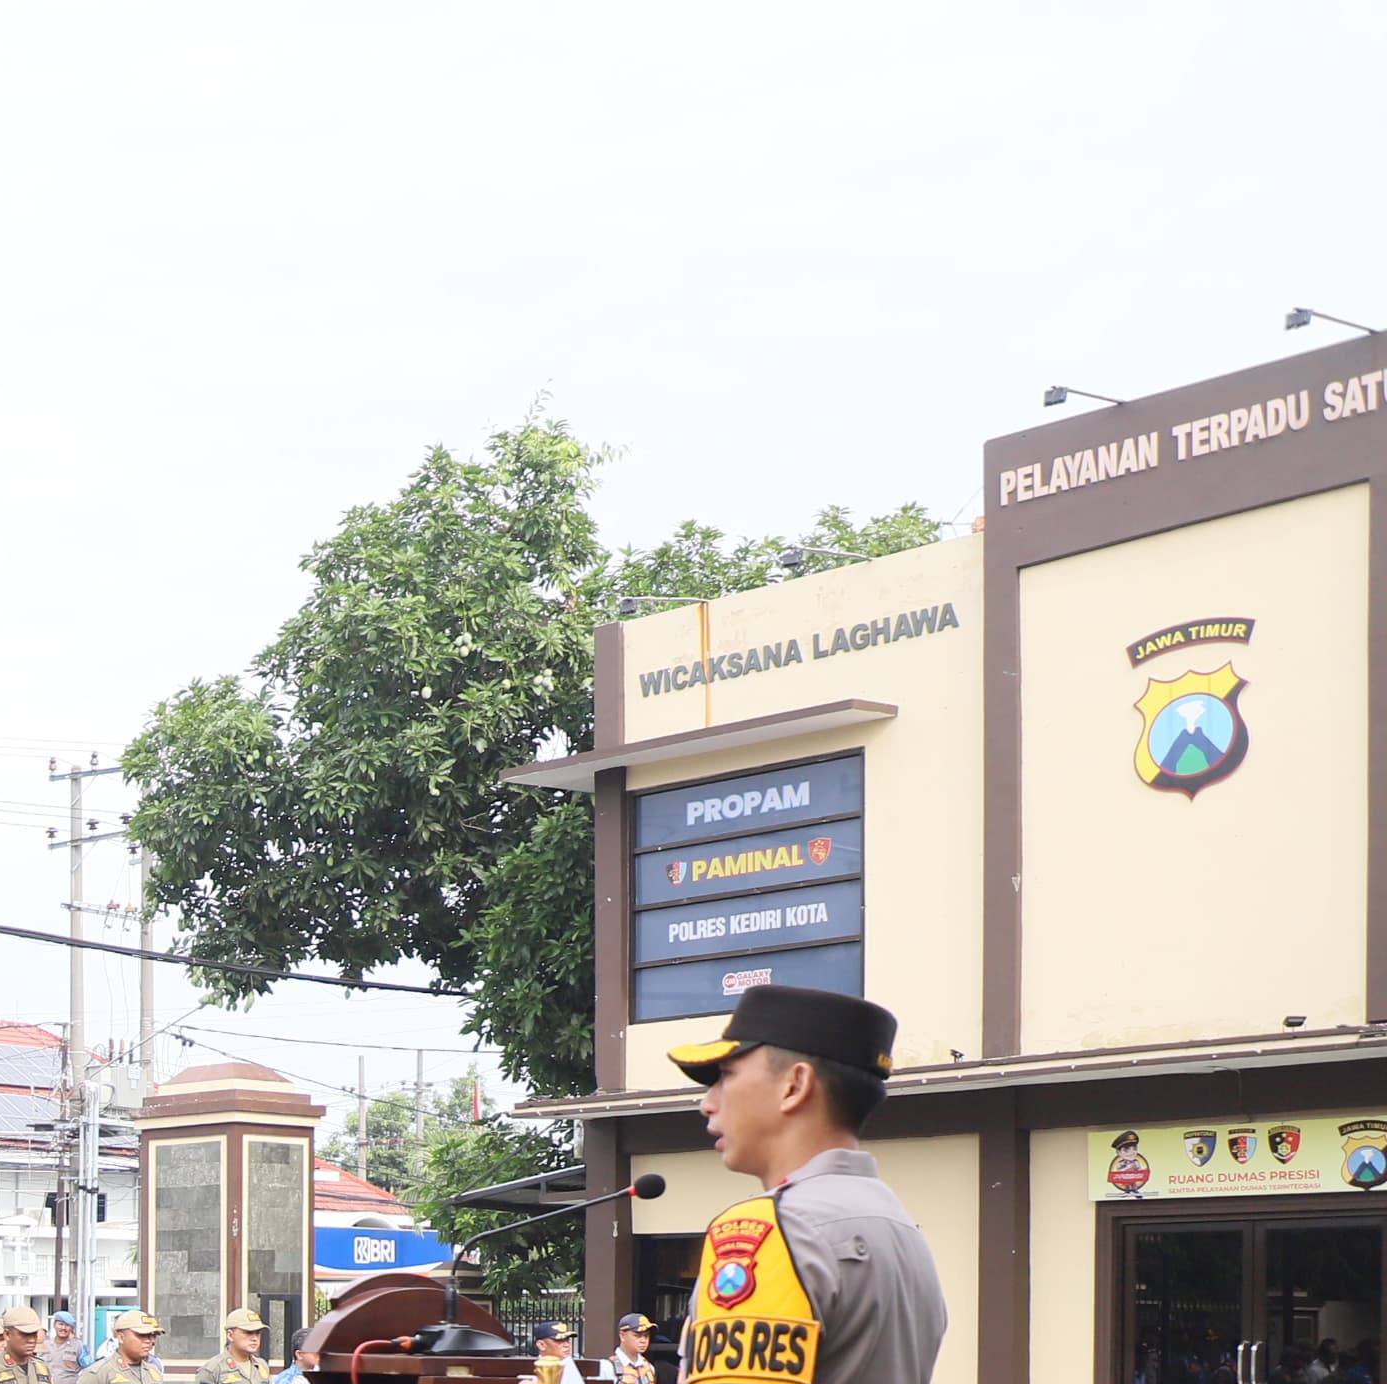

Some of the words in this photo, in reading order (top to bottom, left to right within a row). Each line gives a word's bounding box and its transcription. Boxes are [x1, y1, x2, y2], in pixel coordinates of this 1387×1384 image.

[999, 431, 1159, 507] PELAYANAN
[1171, 389, 1310, 462] TERPADU
[1323, 366, 1387, 422] SAT
[639, 639, 803, 698] WICAKSANA
[812, 602, 960, 660] LAGHAWA
[1135, 631, 1186, 659] JAWA
[1188, 623, 1248, 640] TIMUR
[686, 781, 811, 826] PROPAM
[691, 844, 804, 882] PAMINAL
[668, 915, 726, 943] POLRES
[730, 908, 782, 935] KEDIRI
[786, 902, 828, 927] KOTA
[737, 970, 770, 980] GALAXY
[738, 977, 769, 987] MOTOR
[1168, 1173, 1214, 1185] RUANG
[1218, 1170, 1267, 1183] DUMAS
[1270, 1169, 1320, 1180] PRESISI
[1197, 1185, 1240, 1193] PELAYANAN
[712, 1220, 766, 1235] POLRES
[370, 1239, 396, 1263] BRI
[695, 1320, 746, 1374] OPS
[748, 1320, 809, 1376] RES
